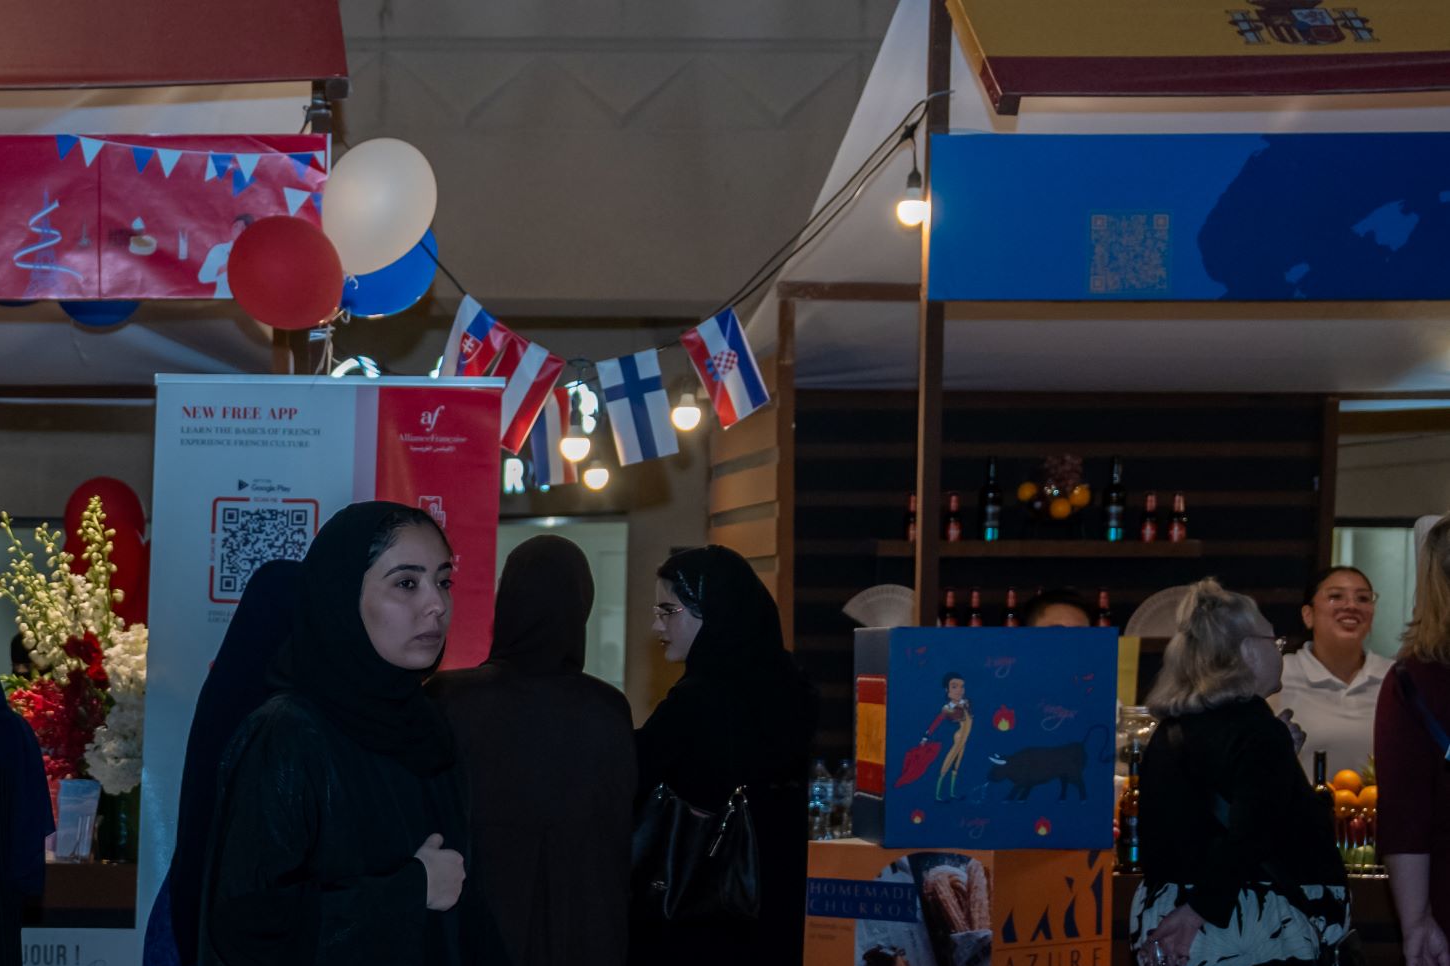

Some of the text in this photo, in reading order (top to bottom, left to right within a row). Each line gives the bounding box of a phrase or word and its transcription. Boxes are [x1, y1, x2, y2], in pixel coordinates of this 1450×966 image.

[182, 406, 299, 420] NEW FREE APP
[180, 425, 321, 436] LEARN THE BASICS OF FRENCH
[180, 438, 310, 448] EXPERIENCE FRENCH CULTURE
[809, 882, 914, 900] HOMEMADE
[809, 898, 914, 917] CHURROS
